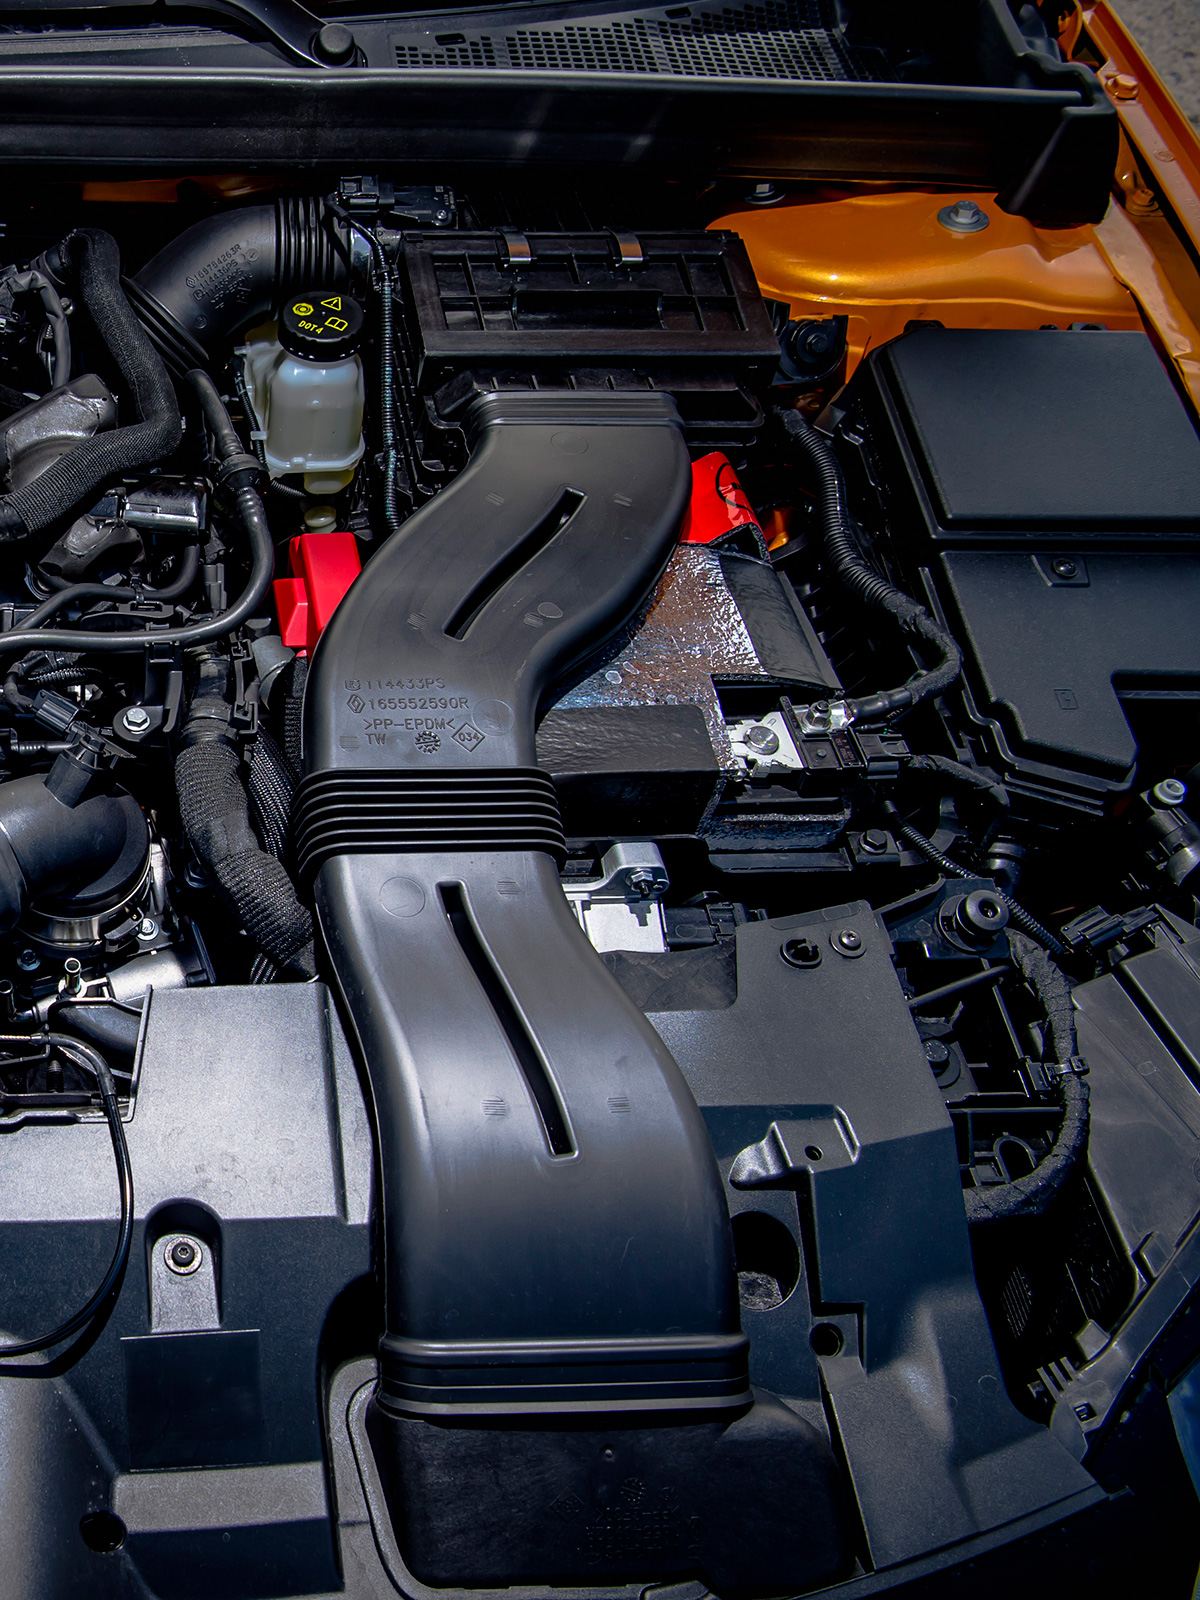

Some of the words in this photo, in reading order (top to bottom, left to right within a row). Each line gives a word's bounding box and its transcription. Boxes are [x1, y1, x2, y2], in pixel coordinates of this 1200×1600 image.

[366, 677, 446, 690] 114433PS
[368, 697, 470, 710] 165552590R
[365, 733, 386, 745] TW
